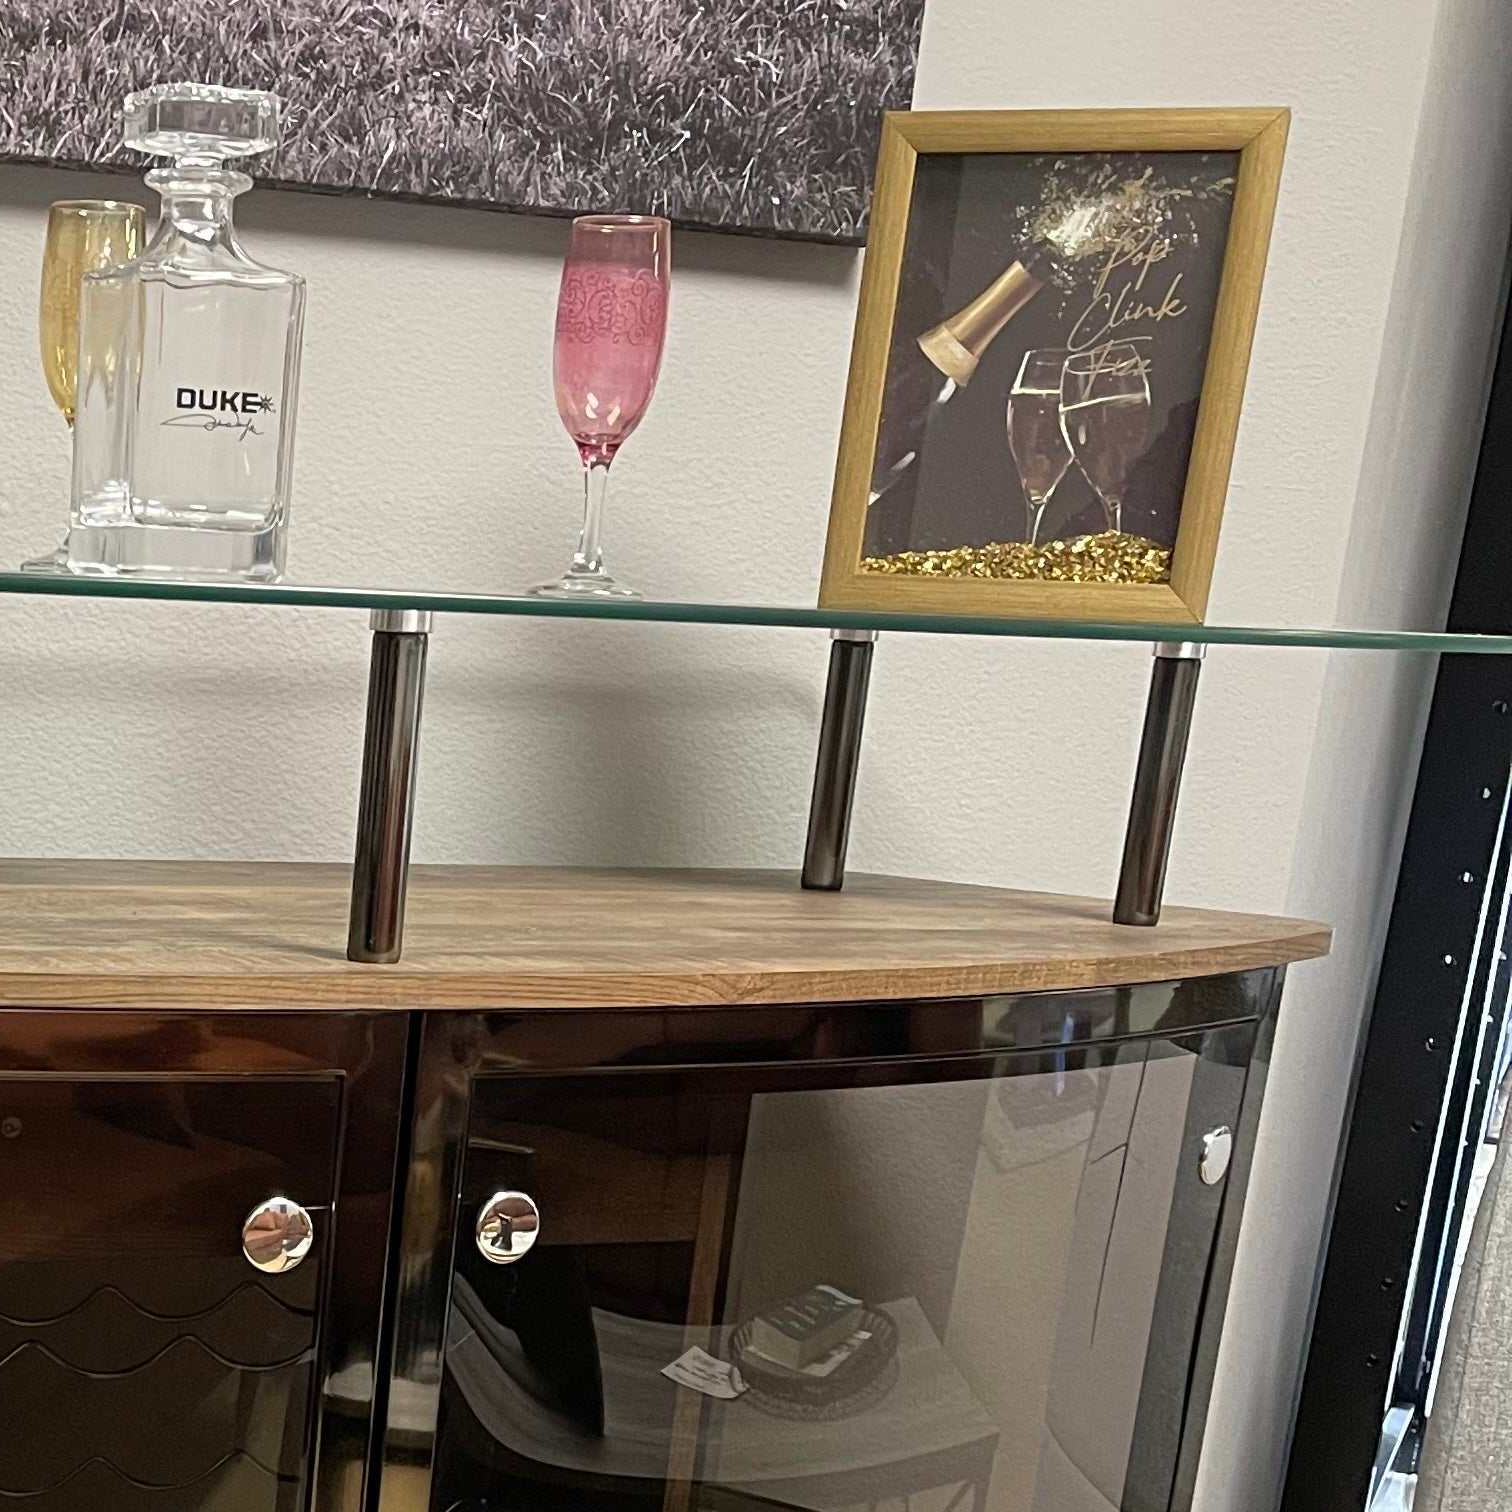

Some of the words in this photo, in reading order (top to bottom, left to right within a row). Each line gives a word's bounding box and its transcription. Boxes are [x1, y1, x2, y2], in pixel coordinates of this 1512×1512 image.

[1093, 226, 1174, 298] Pop
[1067, 273, 1187, 352] Clink
[176, 387, 262, 414] DUKE
[1082, 336, 1152, 400] Fizz
